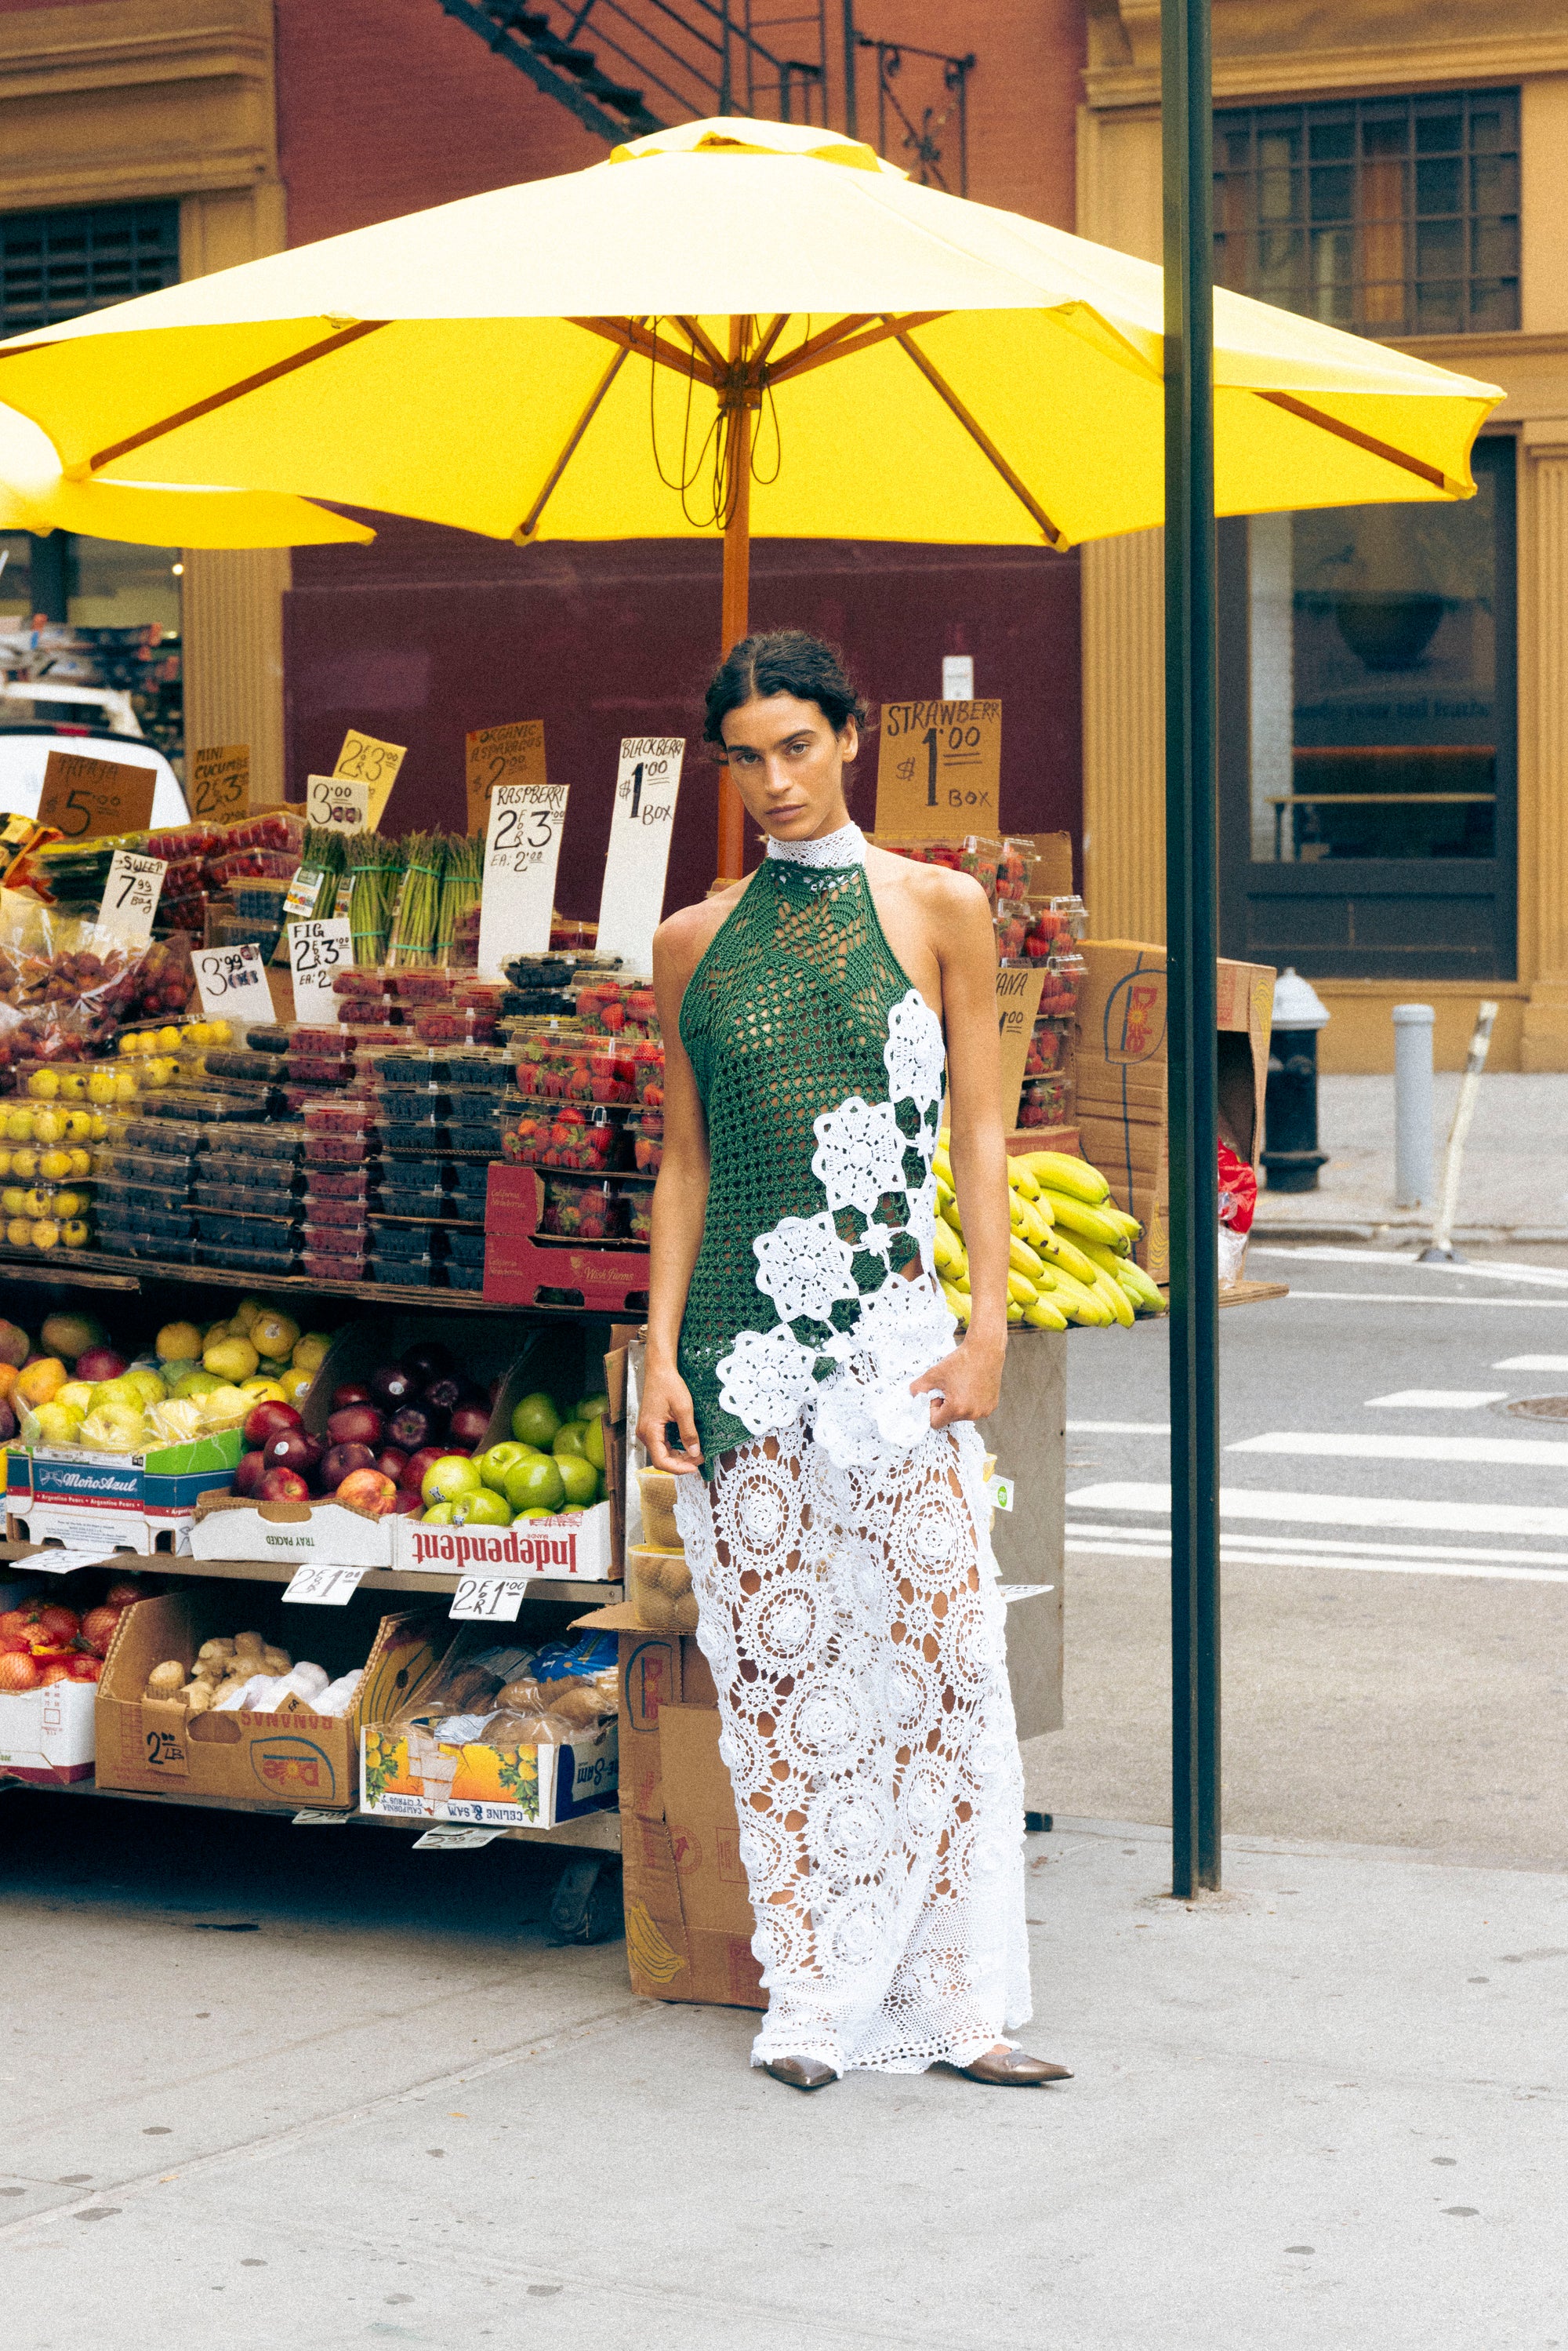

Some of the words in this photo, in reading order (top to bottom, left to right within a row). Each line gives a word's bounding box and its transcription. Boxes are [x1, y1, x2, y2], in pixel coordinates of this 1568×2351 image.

[887, 700, 1000, 736] STRAWBERR
[480, 723, 536, 743] ORGANIC
[195, 747, 223, 763] MINI
[949, 788, 992, 808] BOX
[642, 805, 673, 826] BOX
[494, 809, 521, 850] 2
[294, 923, 325, 938] FIG
[295, 940, 318, 972] 2
[266, 1535, 292, 1546] PACKED
[296, 1538, 315, 1546] TRAY
[412, 1532, 578, 1573] Independent
[452, 1580, 476, 1611] 2
[241, 1711, 333, 1730] BANANAS
[383, 1804, 423, 1815] CALIFORNIA
[390, 1797, 414, 1807] CITRUS
[448, 1805, 470, 1818] SAM
[487, 1808, 523, 1822] CELINE
